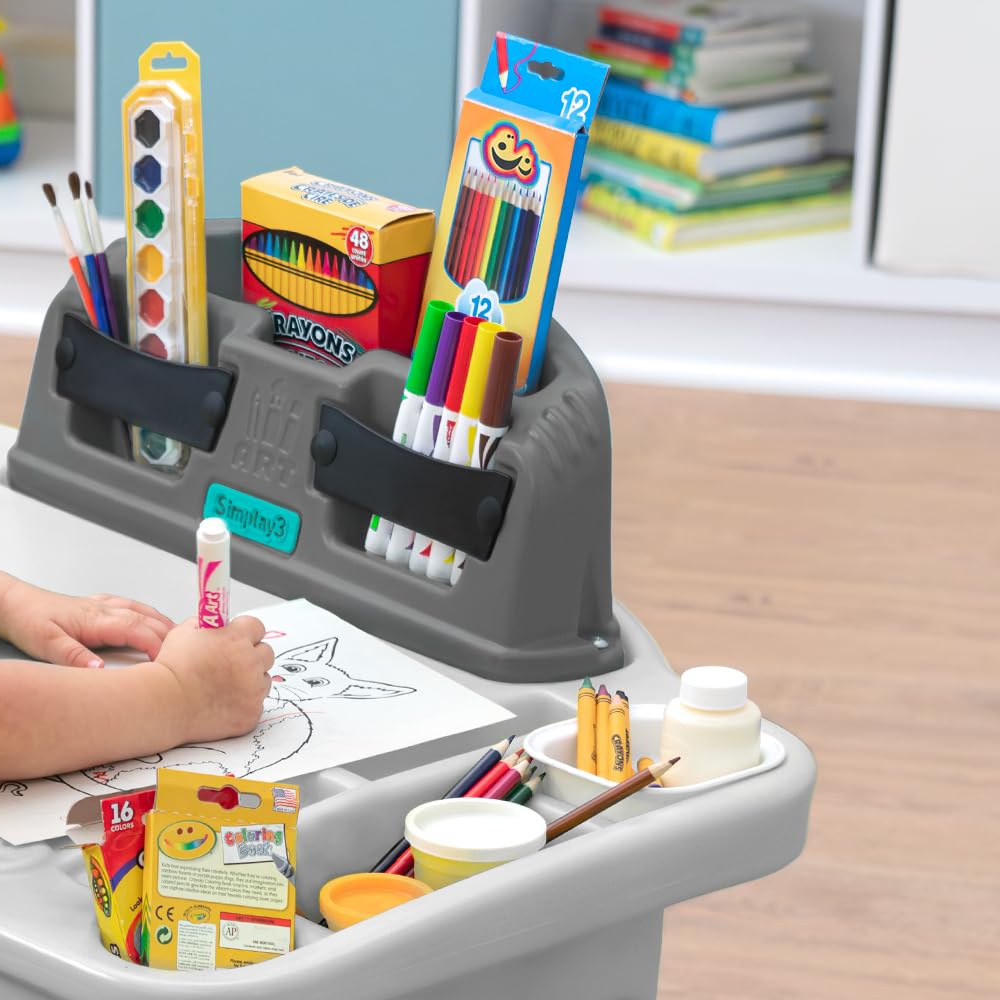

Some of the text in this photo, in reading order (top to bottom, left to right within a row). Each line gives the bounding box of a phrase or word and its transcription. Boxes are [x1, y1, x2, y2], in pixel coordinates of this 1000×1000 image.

[560, 86, 591, 122] 12
[349, 230, 369, 250] 48
[471, 295, 493, 319] 12
[271, 311, 356, 364] RAYONS
[215, 494, 287, 537] Simplay3
[110, 800, 134, 825] 16
[110, 822, 135, 833] COLORS
[224, 827, 283, 846] Coloring
[155, 905, 175, 922] CE
[225, 927, 237, 937] AP
